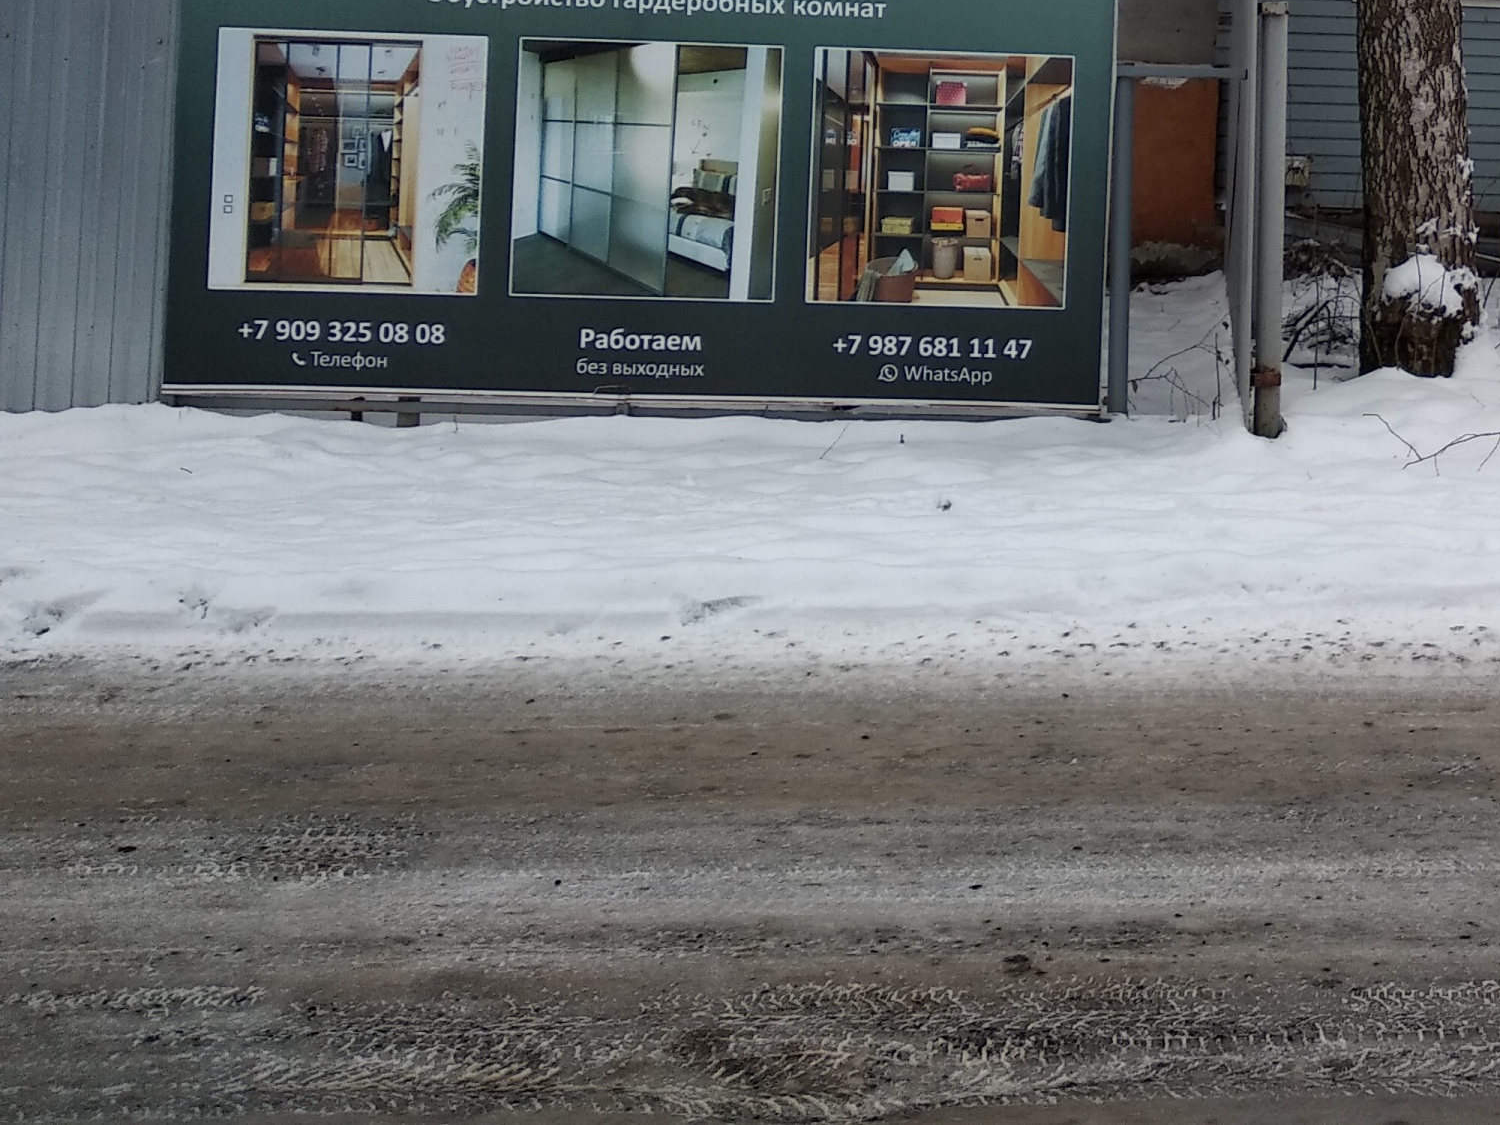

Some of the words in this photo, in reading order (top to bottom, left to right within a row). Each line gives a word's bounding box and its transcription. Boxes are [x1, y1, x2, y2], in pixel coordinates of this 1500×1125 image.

[793, 0, 887, 19] комнат
[237, 319, 269, 340] +7
[275, 320, 321, 341] 909
[327, 321, 372, 343] 325
[379, 322, 409, 344] 08
[415, 323, 445, 345] 08
[579, 328, 702, 351] Работаем
[832, 334, 862, 355] +7
[868, 335, 912, 356] 987
[918, 336, 961, 358] 681
[969, 338, 997, 359] 11
[1002, 339, 1033, 360] 47
[310, 350, 388, 371] Телефон
[576, 357, 608, 376] без
[613, 361, 705, 379] выходных
[904, 365, 993, 386] WhatsApp
